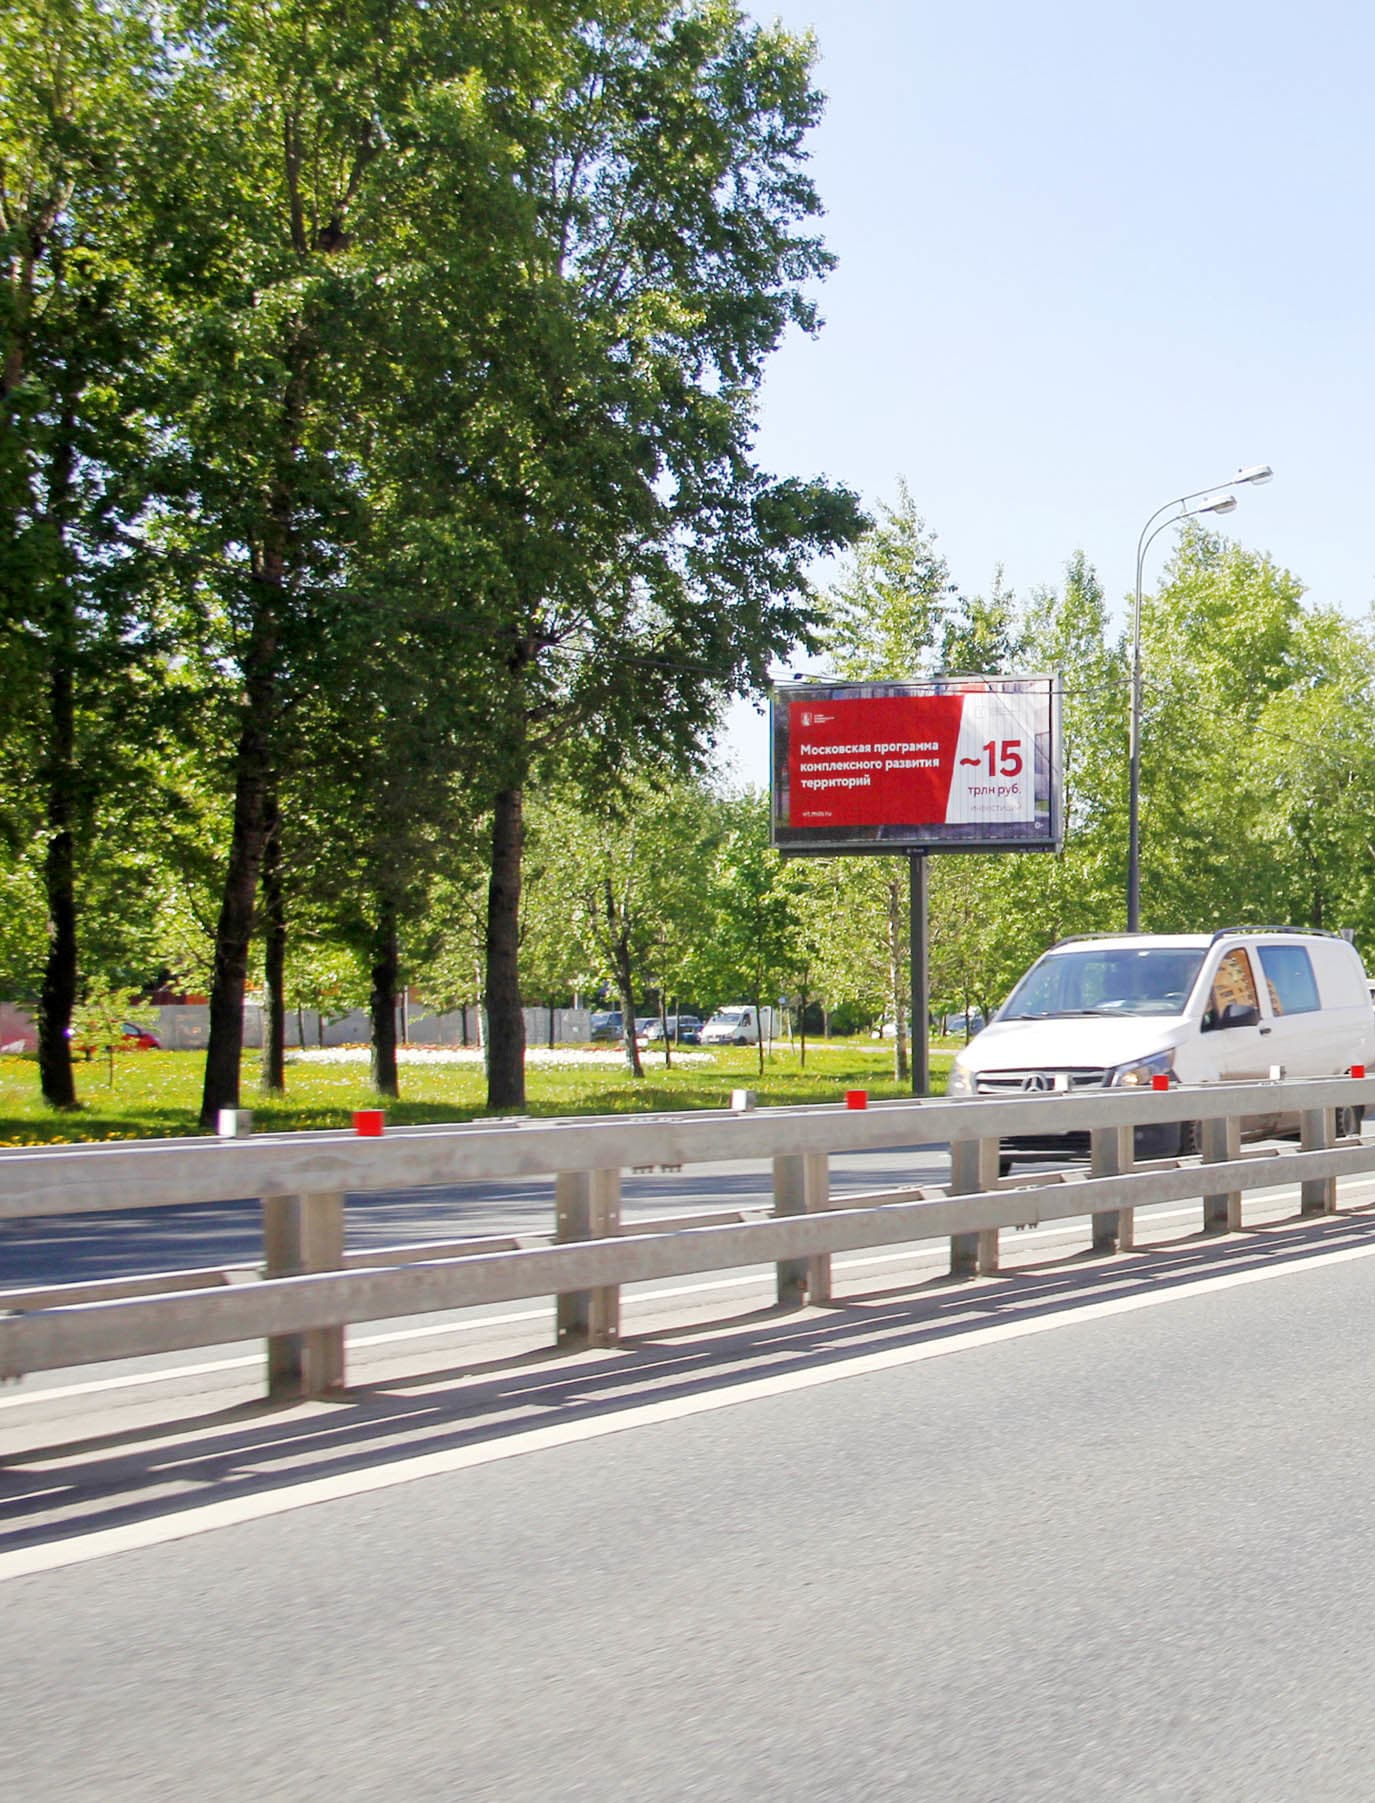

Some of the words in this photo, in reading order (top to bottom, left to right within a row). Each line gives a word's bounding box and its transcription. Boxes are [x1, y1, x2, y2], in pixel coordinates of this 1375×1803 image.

[800, 744, 872, 756] Московская
[873, 741, 939, 755] программа
[800, 760, 883, 772] комплексного
[885, 758, 940, 771] развития
[801, 774, 871, 791] территорий
[968, 786, 996, 798] трлн
[997, 782, 1022, 797] руб.
